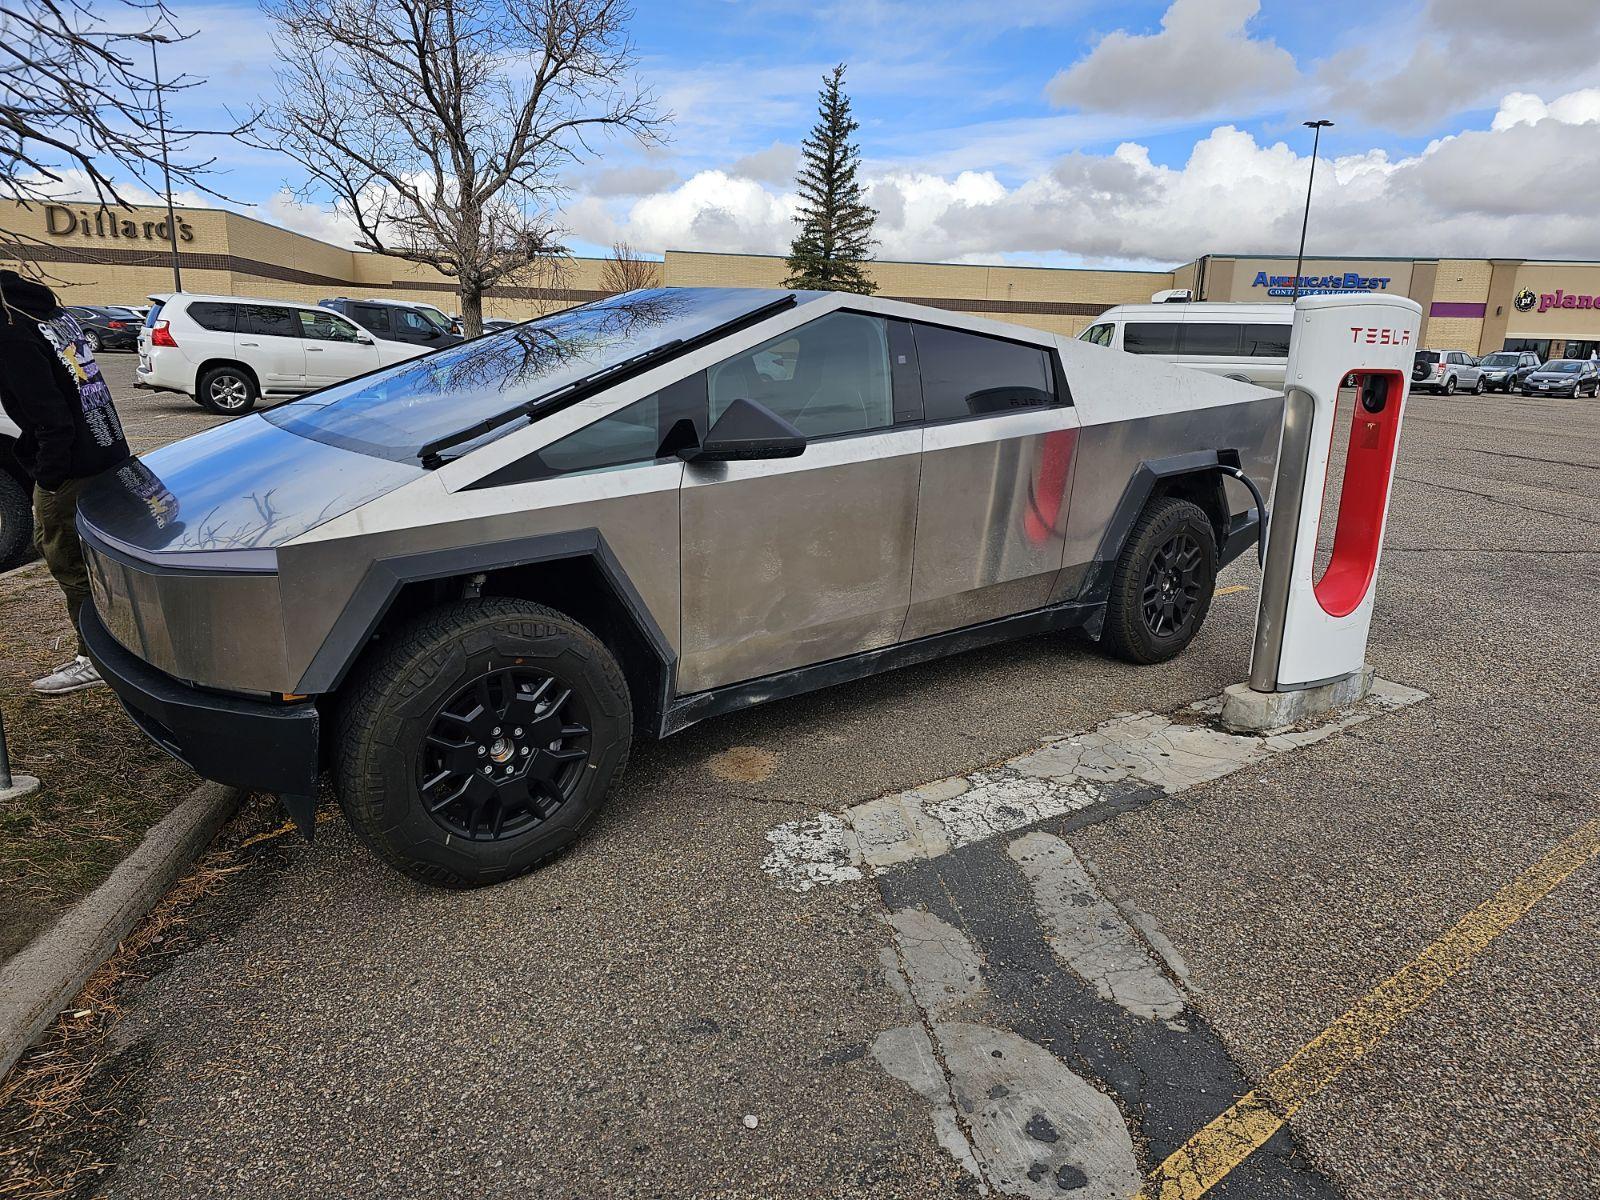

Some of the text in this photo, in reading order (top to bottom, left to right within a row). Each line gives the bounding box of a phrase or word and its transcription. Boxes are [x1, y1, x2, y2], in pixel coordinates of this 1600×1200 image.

[45, 205, 194, 241] Dillard's
[1252, 271, 1391, 289] AMERICA'S BEST
[1350, 327, 1411, 345] TESLA
